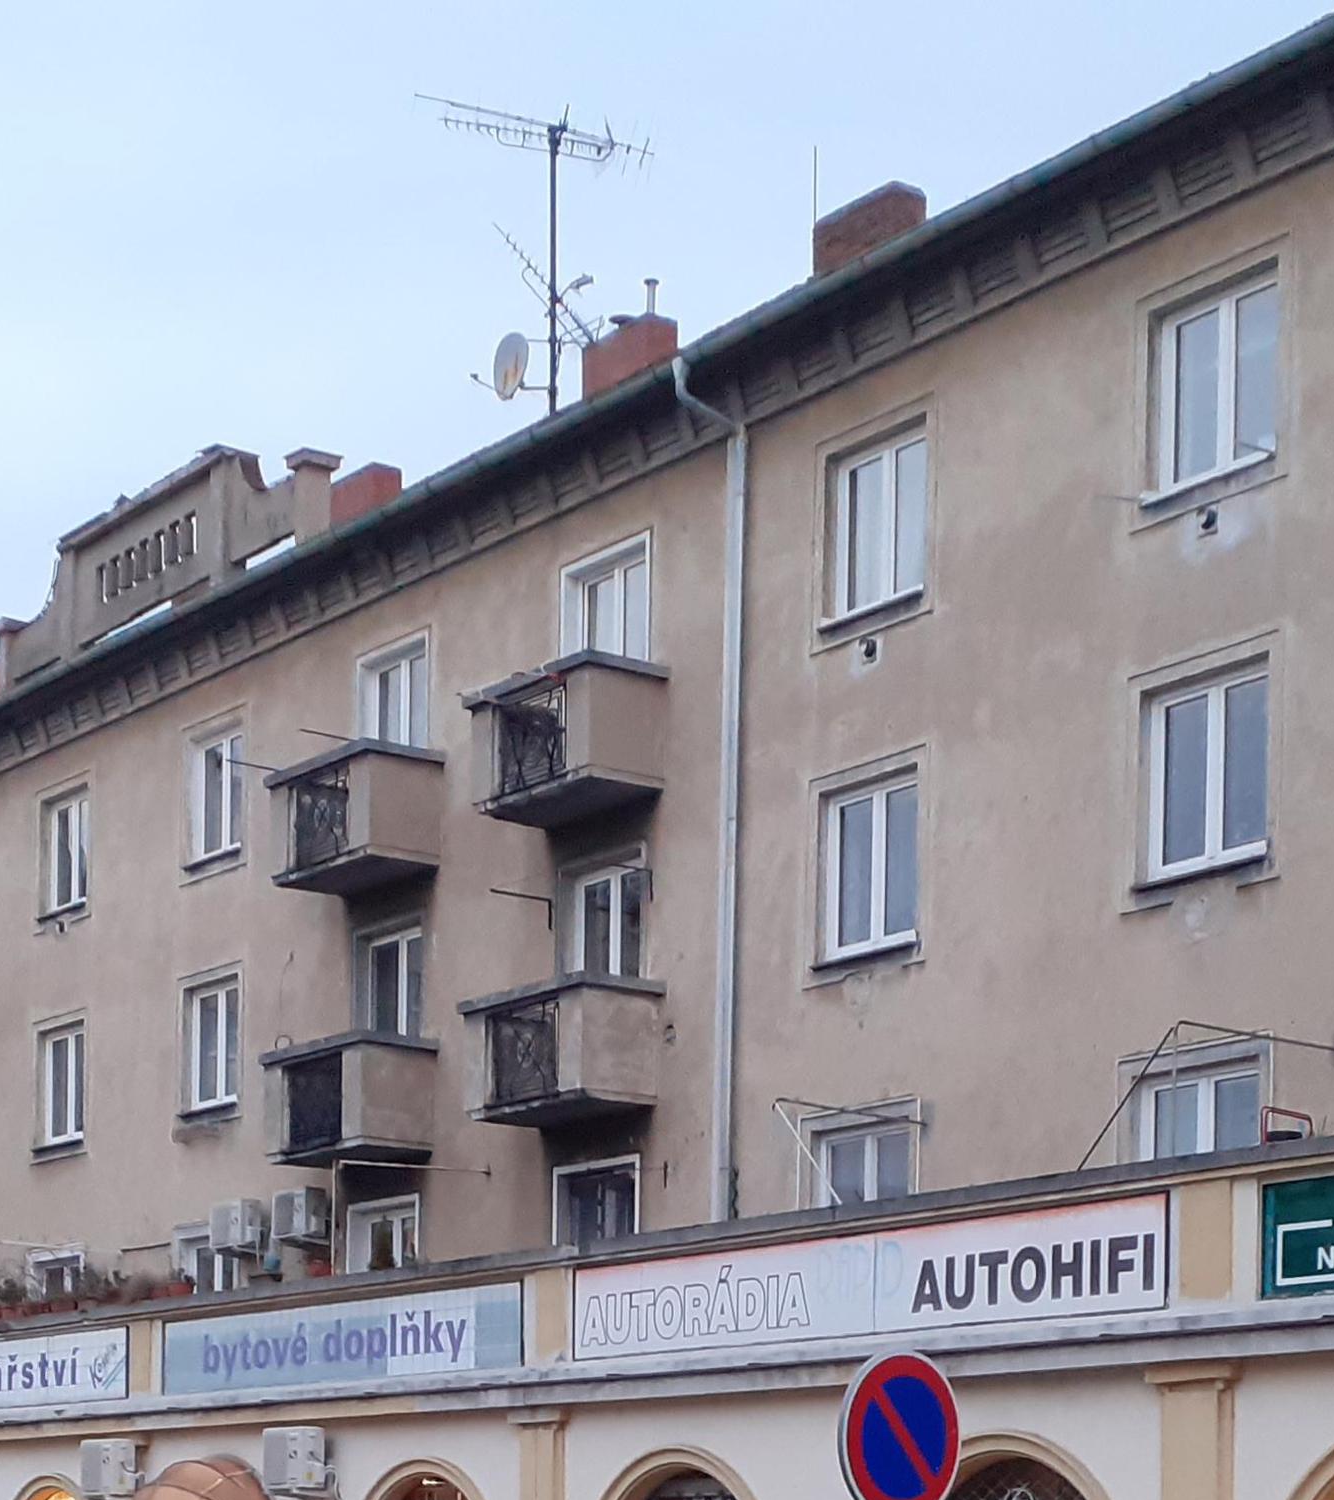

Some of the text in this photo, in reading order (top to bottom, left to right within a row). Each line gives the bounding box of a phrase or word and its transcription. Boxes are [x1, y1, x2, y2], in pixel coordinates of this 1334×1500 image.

[581, 1264, 811, 1347] AUTORÁDIA
[911, 1232, 1156, 1314] AUTOHIFI
[203, 1309, 467, 1380] bytové doplňky
